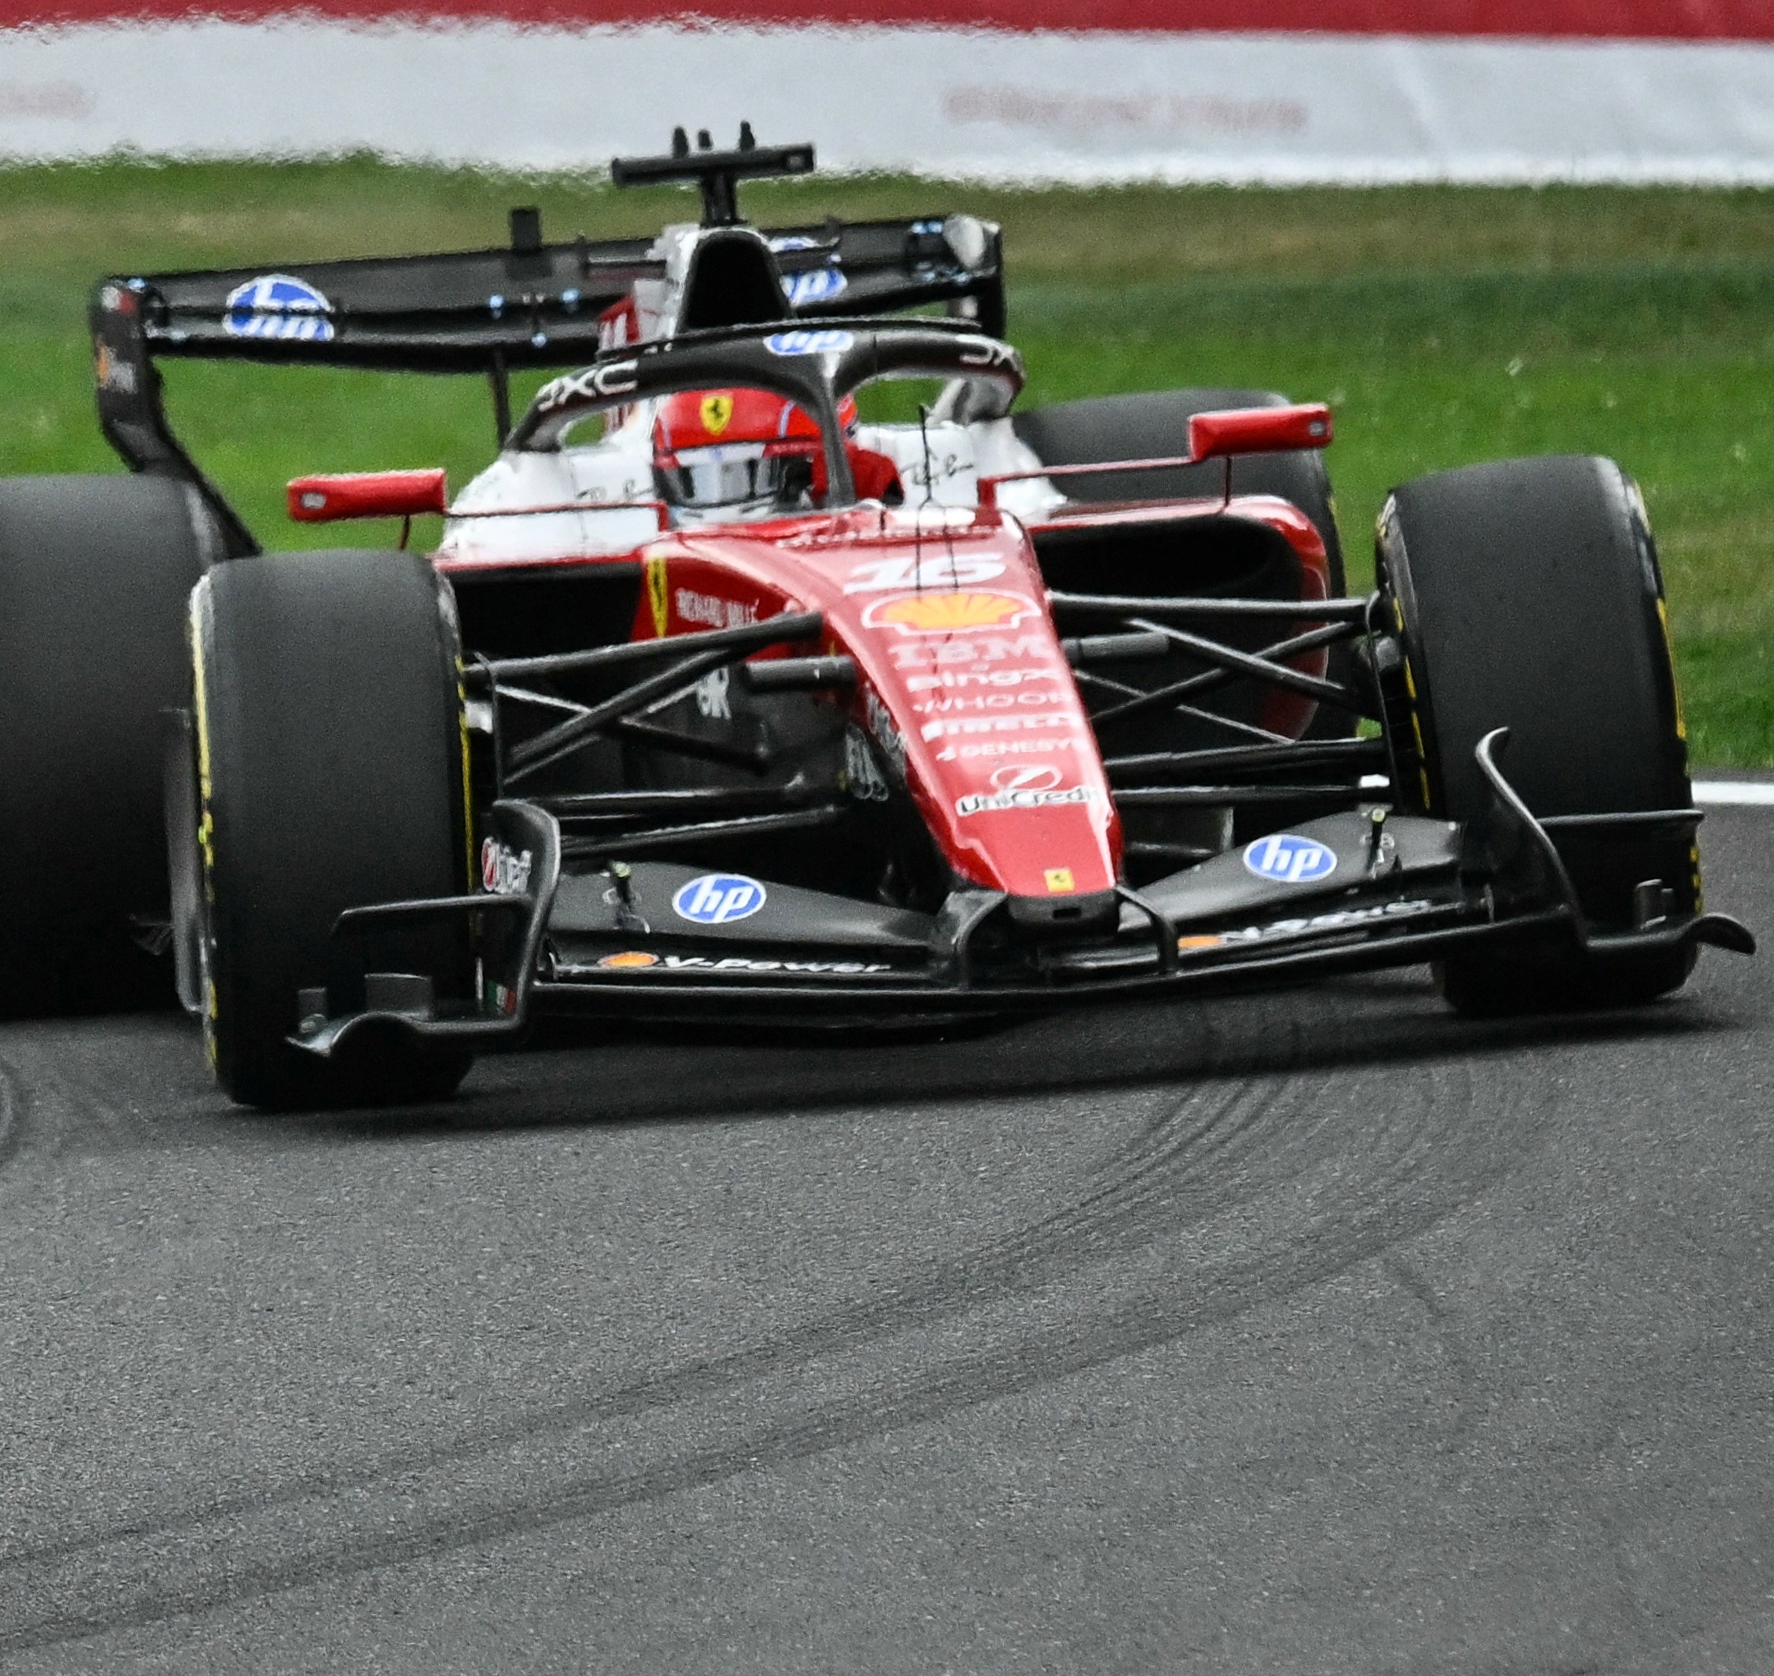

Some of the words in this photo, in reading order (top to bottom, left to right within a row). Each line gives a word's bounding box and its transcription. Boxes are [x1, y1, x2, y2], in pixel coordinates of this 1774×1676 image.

[843, 553, 1007, 595] 16
[888, 634, 1056, 671] IBM
[1260, 834, 1323, 882] hp
[689, 875, 755, 923] hp
[665, 954, 892, 973] V-Power
